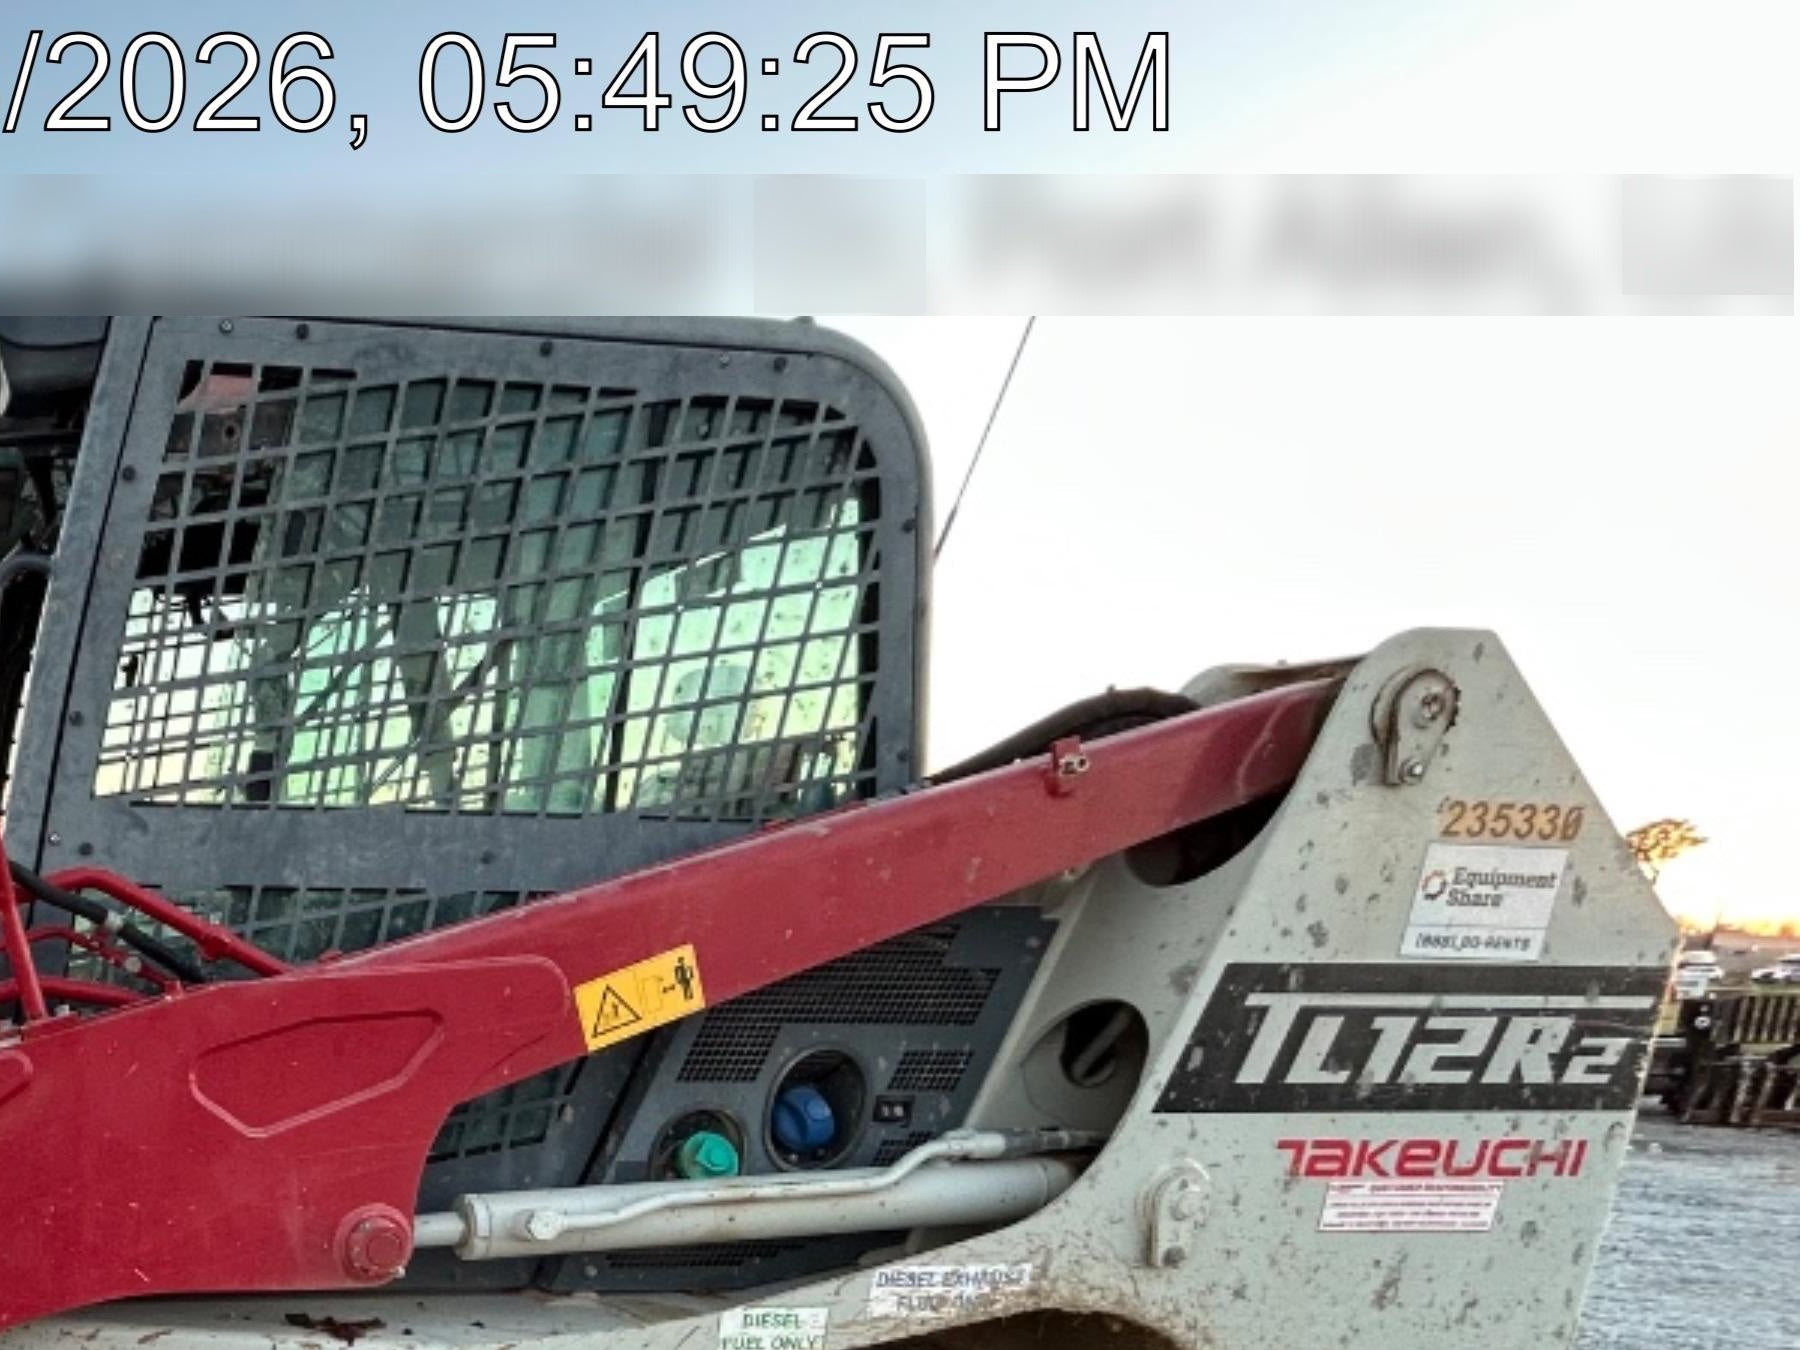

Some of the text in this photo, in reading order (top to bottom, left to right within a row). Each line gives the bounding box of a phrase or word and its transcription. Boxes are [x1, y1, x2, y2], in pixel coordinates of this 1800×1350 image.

[1440, 799, 1585, 842] 235330
[1451, 866, 1558, 890] Equipment
[1446, 887, 1504, 907] Share
[1234, 991, 1656, 1085] TL12R2
[1277, 1138, 1589, 1178] TAKEUCHI
[876, 1270, 937, 1288] DIESEL
[743, 1313, 801, 1330] DIESEL
[722, 1335, 817, 1350] FUEL ONLY
